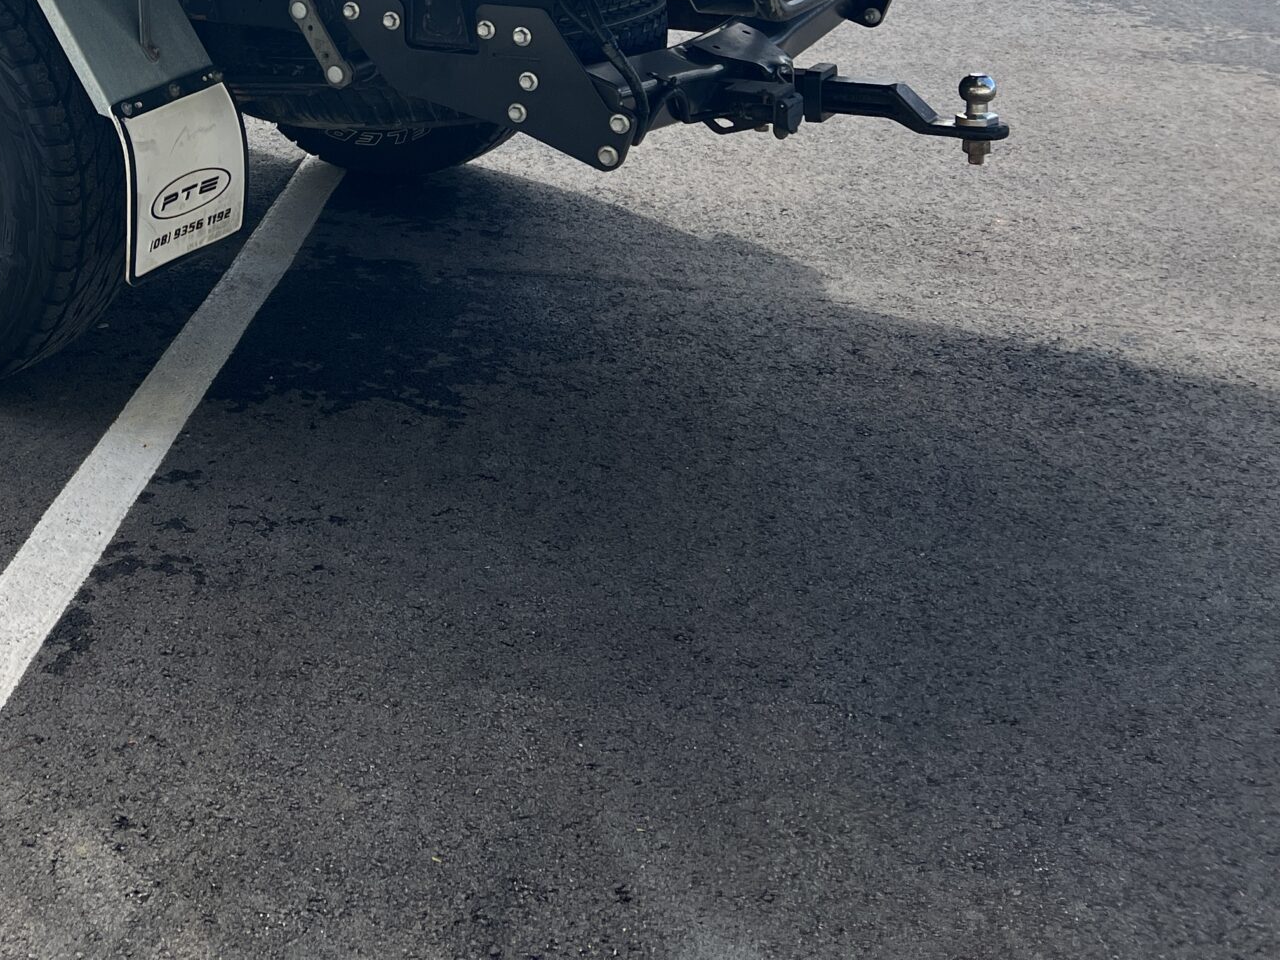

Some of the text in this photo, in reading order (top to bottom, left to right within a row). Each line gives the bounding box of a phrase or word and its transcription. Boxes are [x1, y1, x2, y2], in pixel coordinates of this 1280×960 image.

[161, 176, 220, 212] PTE
[149, 207, 232, 253] (08) 9356 1192
